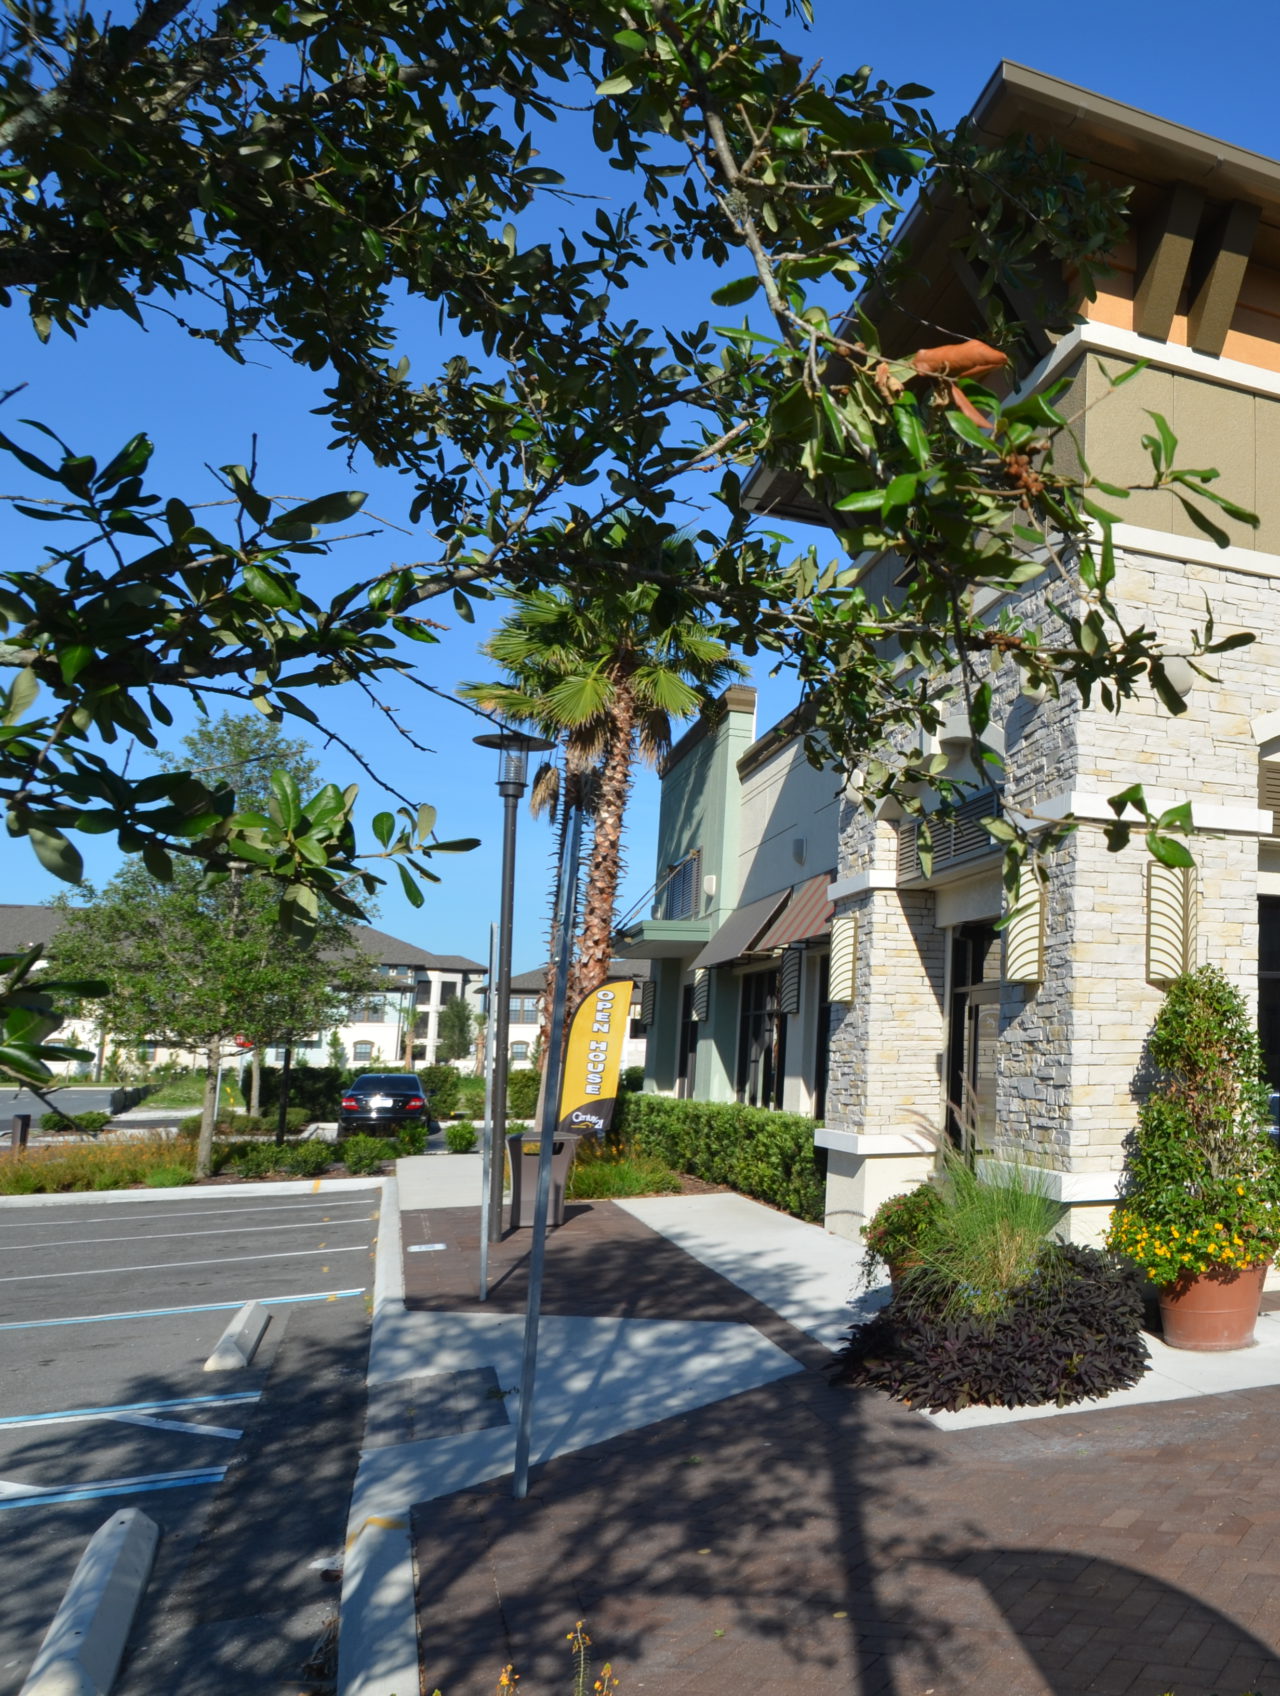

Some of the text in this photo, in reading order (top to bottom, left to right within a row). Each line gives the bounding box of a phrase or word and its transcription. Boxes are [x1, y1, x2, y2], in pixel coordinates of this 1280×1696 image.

[585, 990, 615, 1095] OPEN HOUSE
[572, 1111, 604, 1128] Century 21
